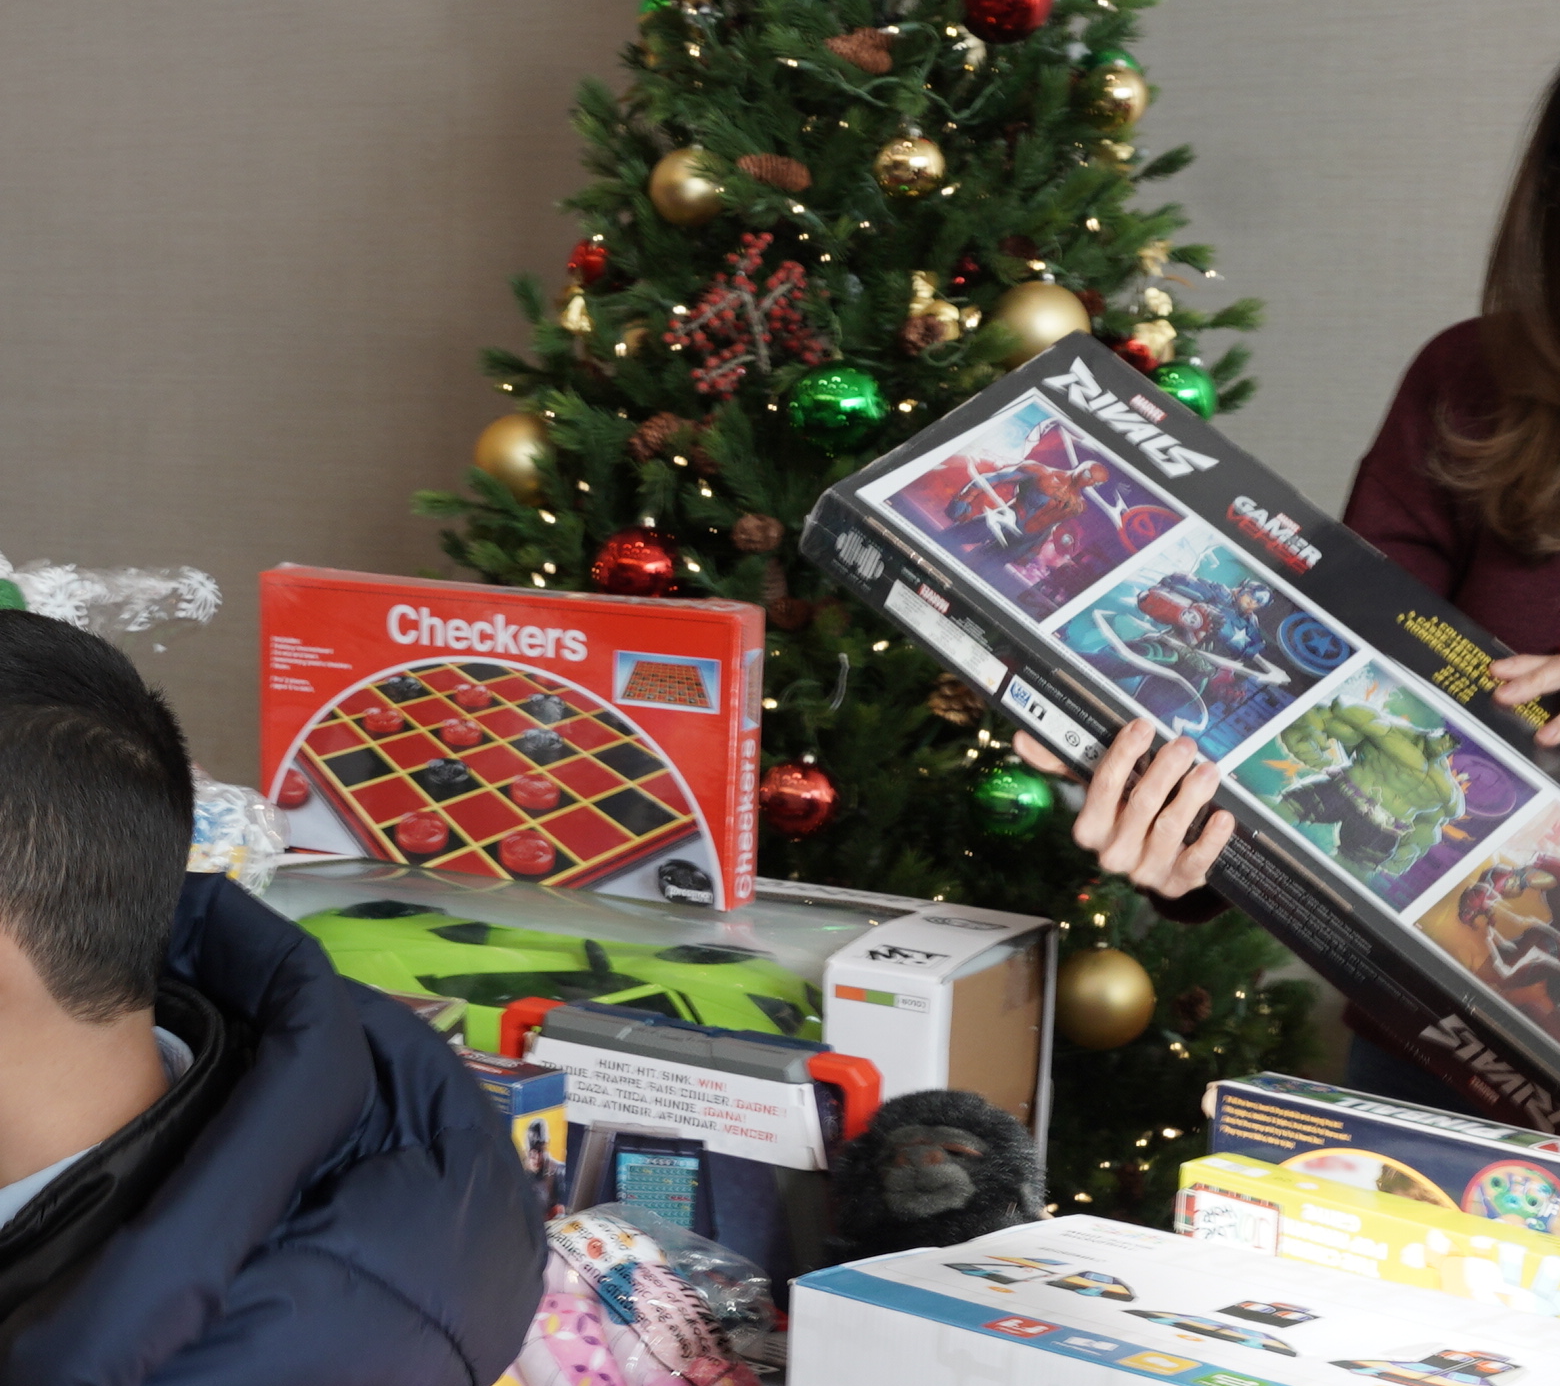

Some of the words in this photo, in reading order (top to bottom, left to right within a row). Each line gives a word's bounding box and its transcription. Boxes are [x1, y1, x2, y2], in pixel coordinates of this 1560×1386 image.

[1042, 357, 1220, 479] RIVALS
[1130, 394, 1167, 424] MARVEL
[1234, 496, 1323, 570] GAMER
[918, 583, 950, 614] MARVEL
[386, 604, 588, 662] Checkers
[734, 736, 757, 901] Checkers
[697, 1078, 727, 1093] WIN!
